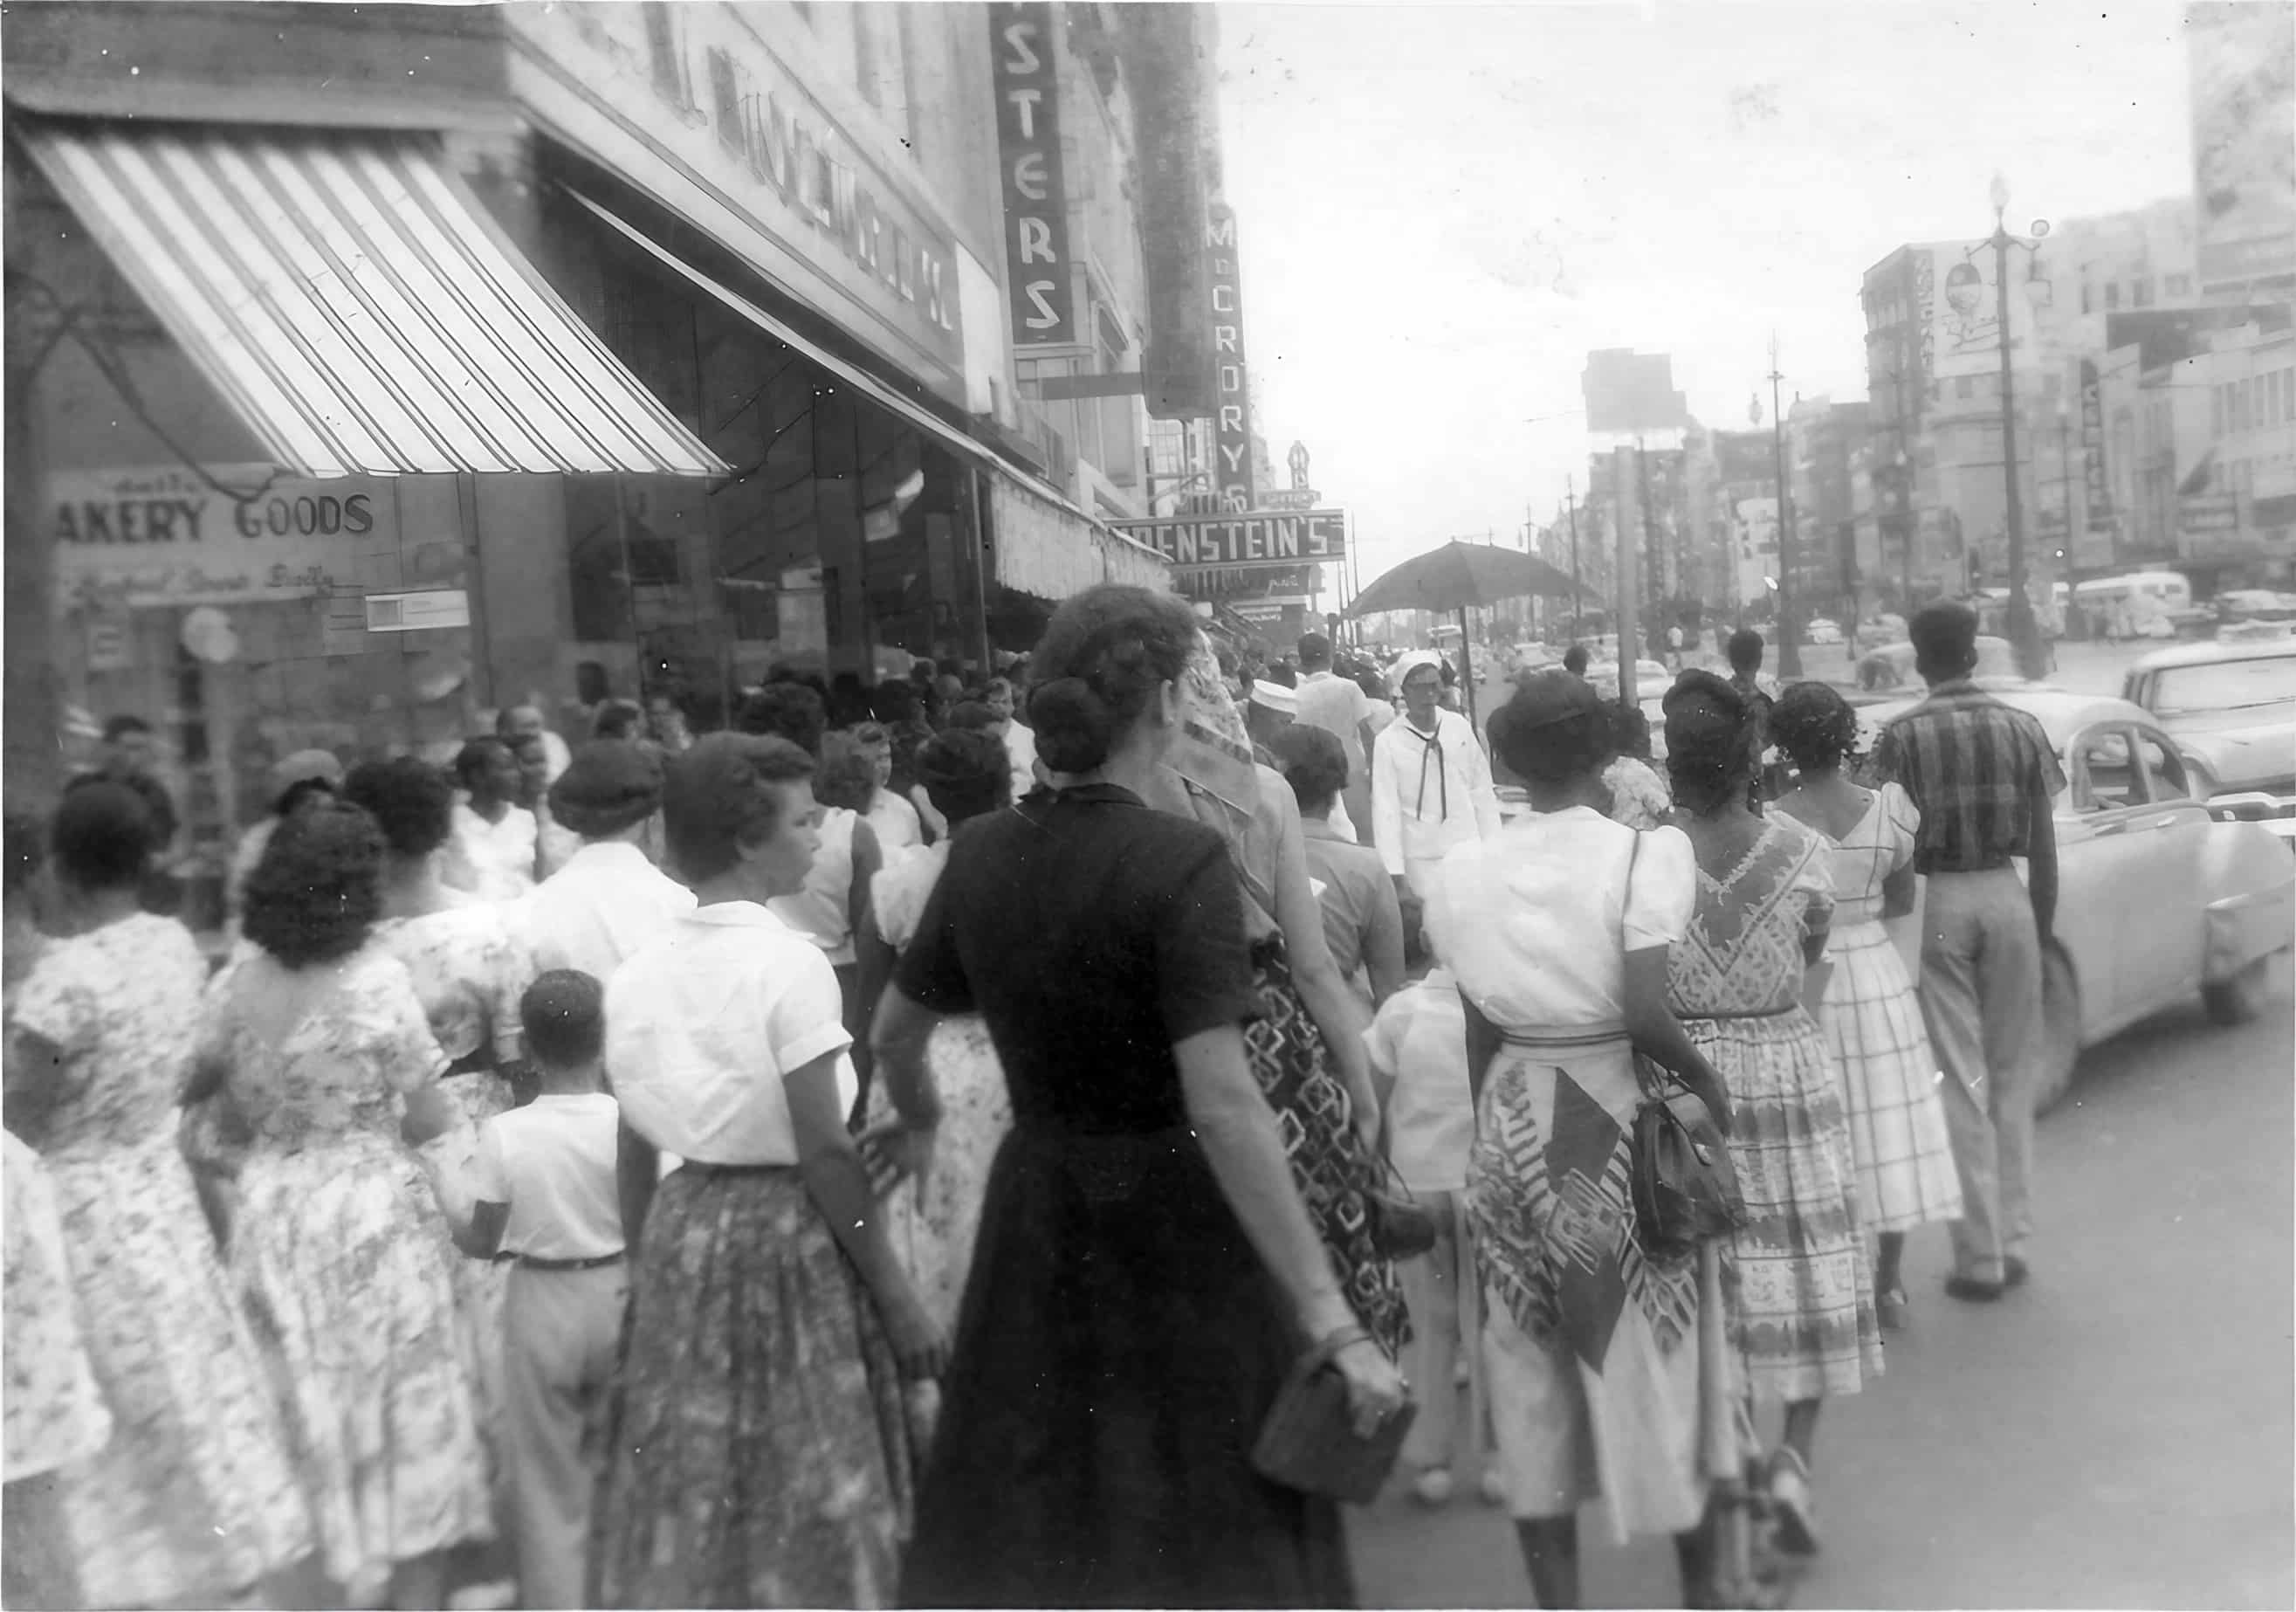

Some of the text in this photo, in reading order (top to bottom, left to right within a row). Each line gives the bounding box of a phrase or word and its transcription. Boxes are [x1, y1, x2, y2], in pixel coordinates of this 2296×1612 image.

[1004, 3, 1061, 328] STERS
[54, 493, 373, 543] AKERY GOODS
